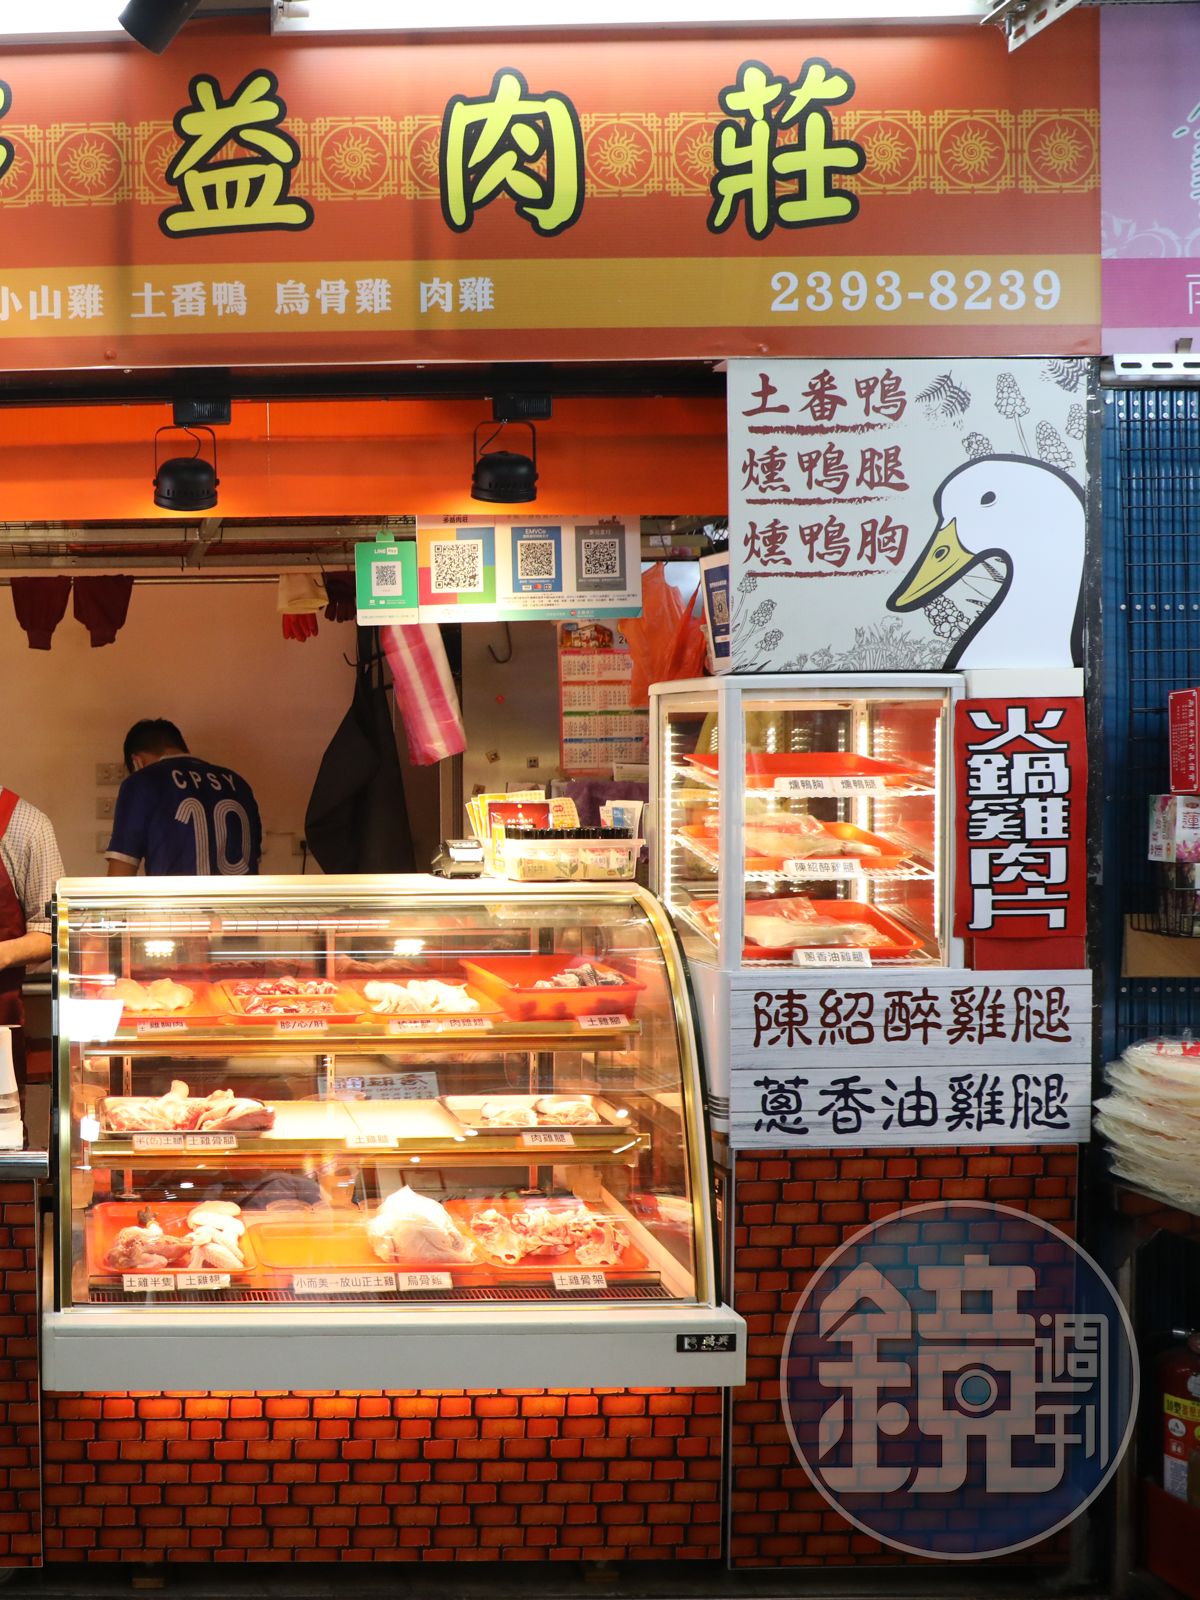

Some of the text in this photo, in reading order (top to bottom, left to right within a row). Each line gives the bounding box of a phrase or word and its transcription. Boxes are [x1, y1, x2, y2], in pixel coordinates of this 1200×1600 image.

[131, 280, 247, 318] 土番鴨
[275, 278, 392, 315] 烏骨雞
[419, 277, 495, 313] 肉雞
[770, 269, 1062, 312] 2393-8239
[742, 368, 907, 420] 土番鴨
[741, 443, 910, 495] 燻鴨腿
[743, 518, 907, 568] 燻鴨胸
[171, 769, 237, 793] CPSY
[174, 797, 252, 876] 10
[966, 705, 1071, 932] 火鍋雞肉片
[753, 986, 1072, 1048] 陳紹醉雞腿
[754, 1073, 1072, 1135] 蔥香油雞腿
